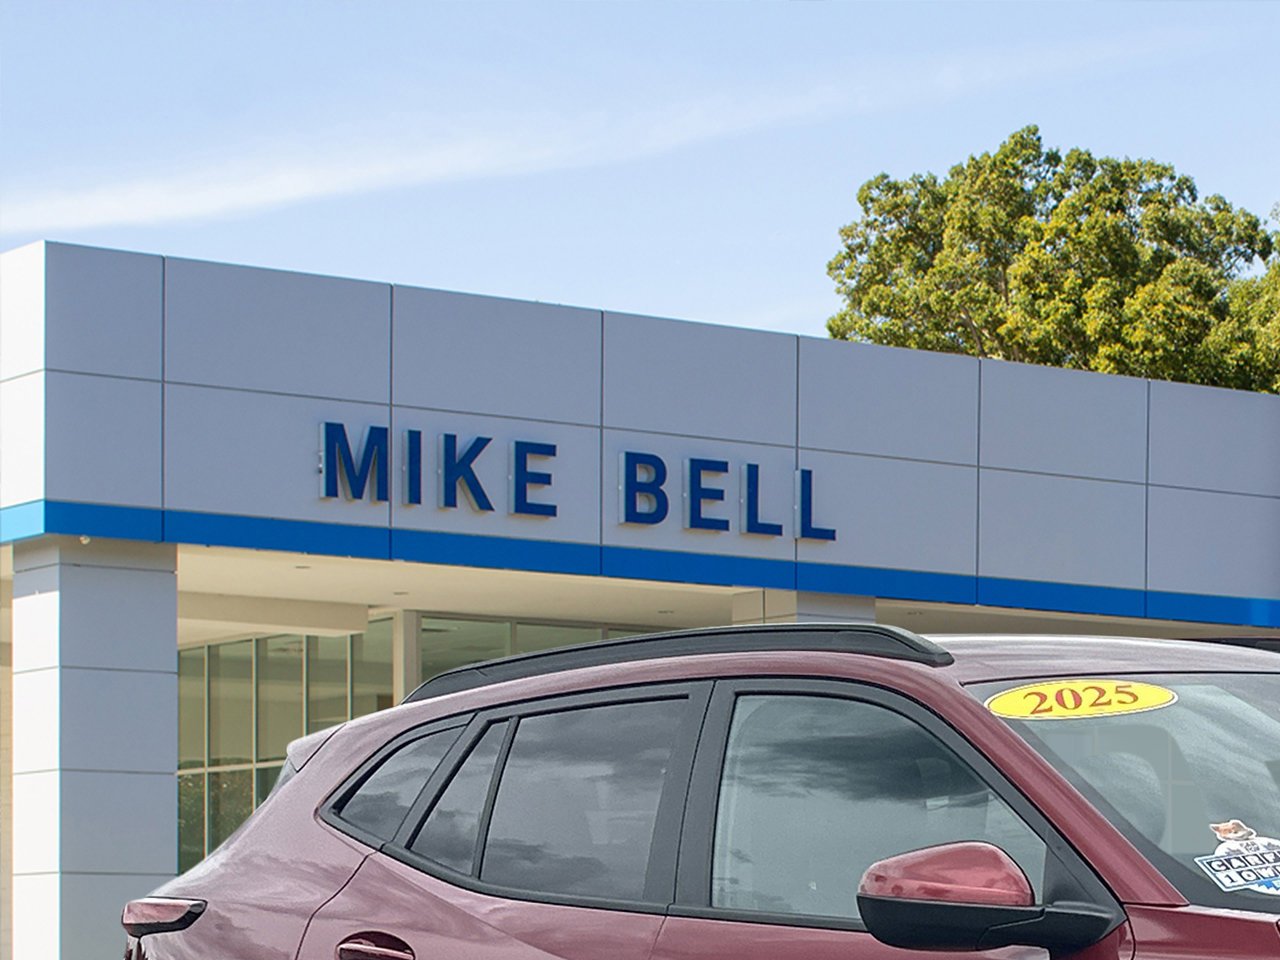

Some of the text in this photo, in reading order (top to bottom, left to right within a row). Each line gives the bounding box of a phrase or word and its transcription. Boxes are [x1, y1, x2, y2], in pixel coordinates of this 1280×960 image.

[319, 421, 837, 542] MIKE BELL
[1023, 684, 1139, 715] 2025
[1223, 873, 1239, 885] 1
